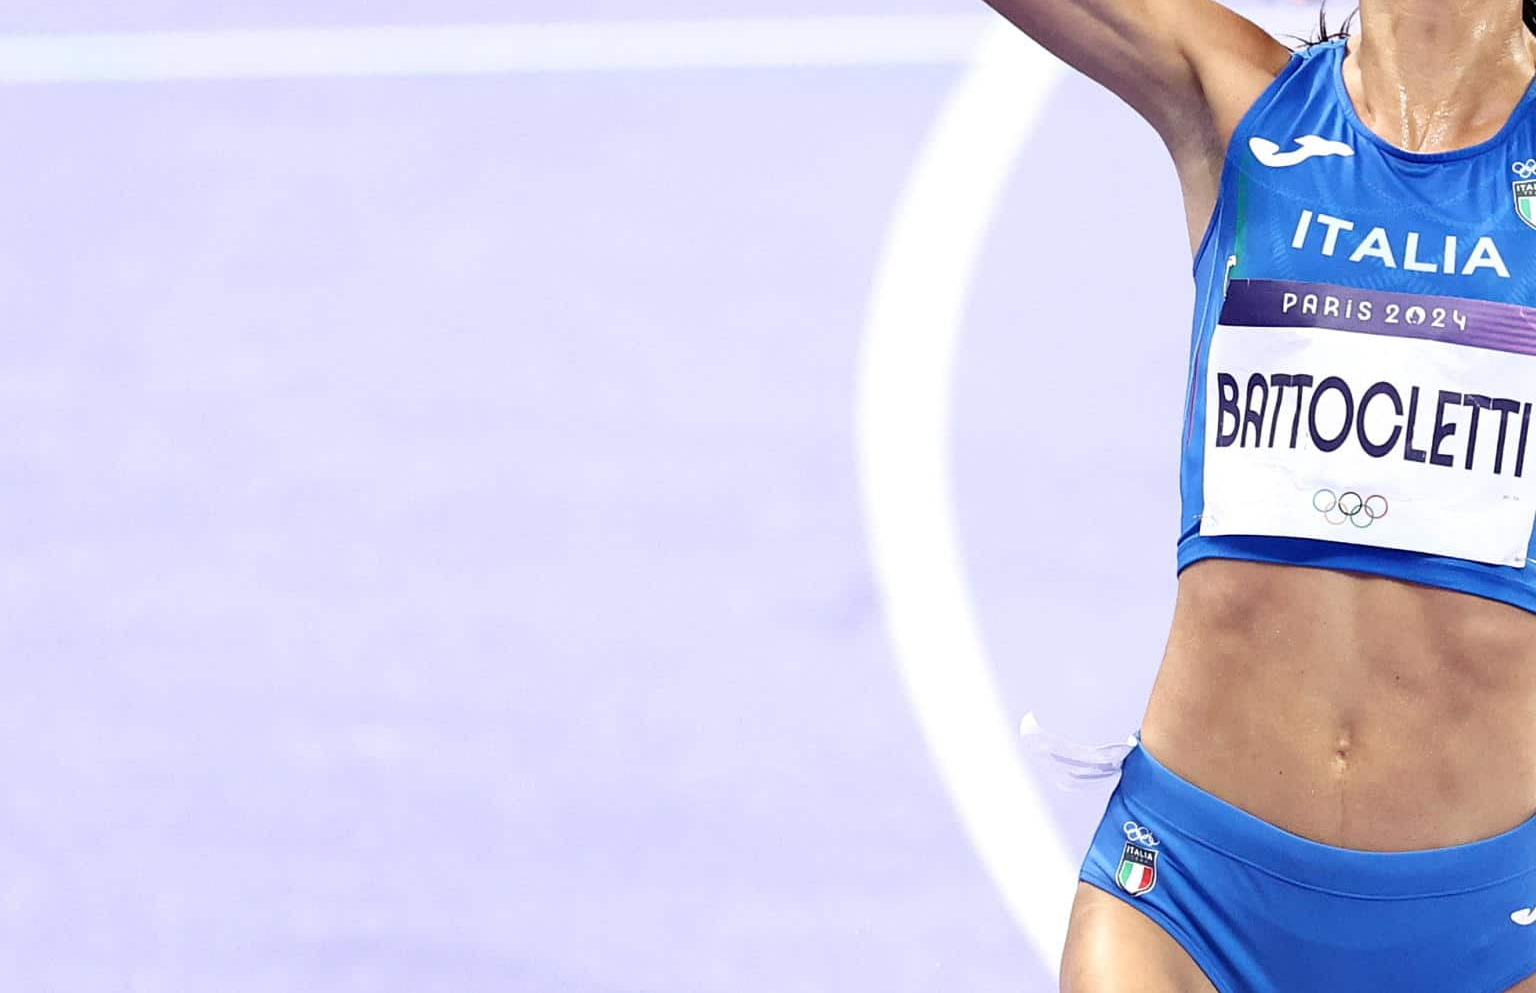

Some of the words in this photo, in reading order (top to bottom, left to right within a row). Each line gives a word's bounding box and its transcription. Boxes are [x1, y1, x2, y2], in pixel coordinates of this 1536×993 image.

[1291, 209, 1511, 278] ITALIA
[1282, 292, 1372, 321] PARIS
[1384, 303, 1467, 331] 2024
[1215, 372, 1533, 478] BATTOCLETTI
[1126, 845, 1153, 861] ITALIA
